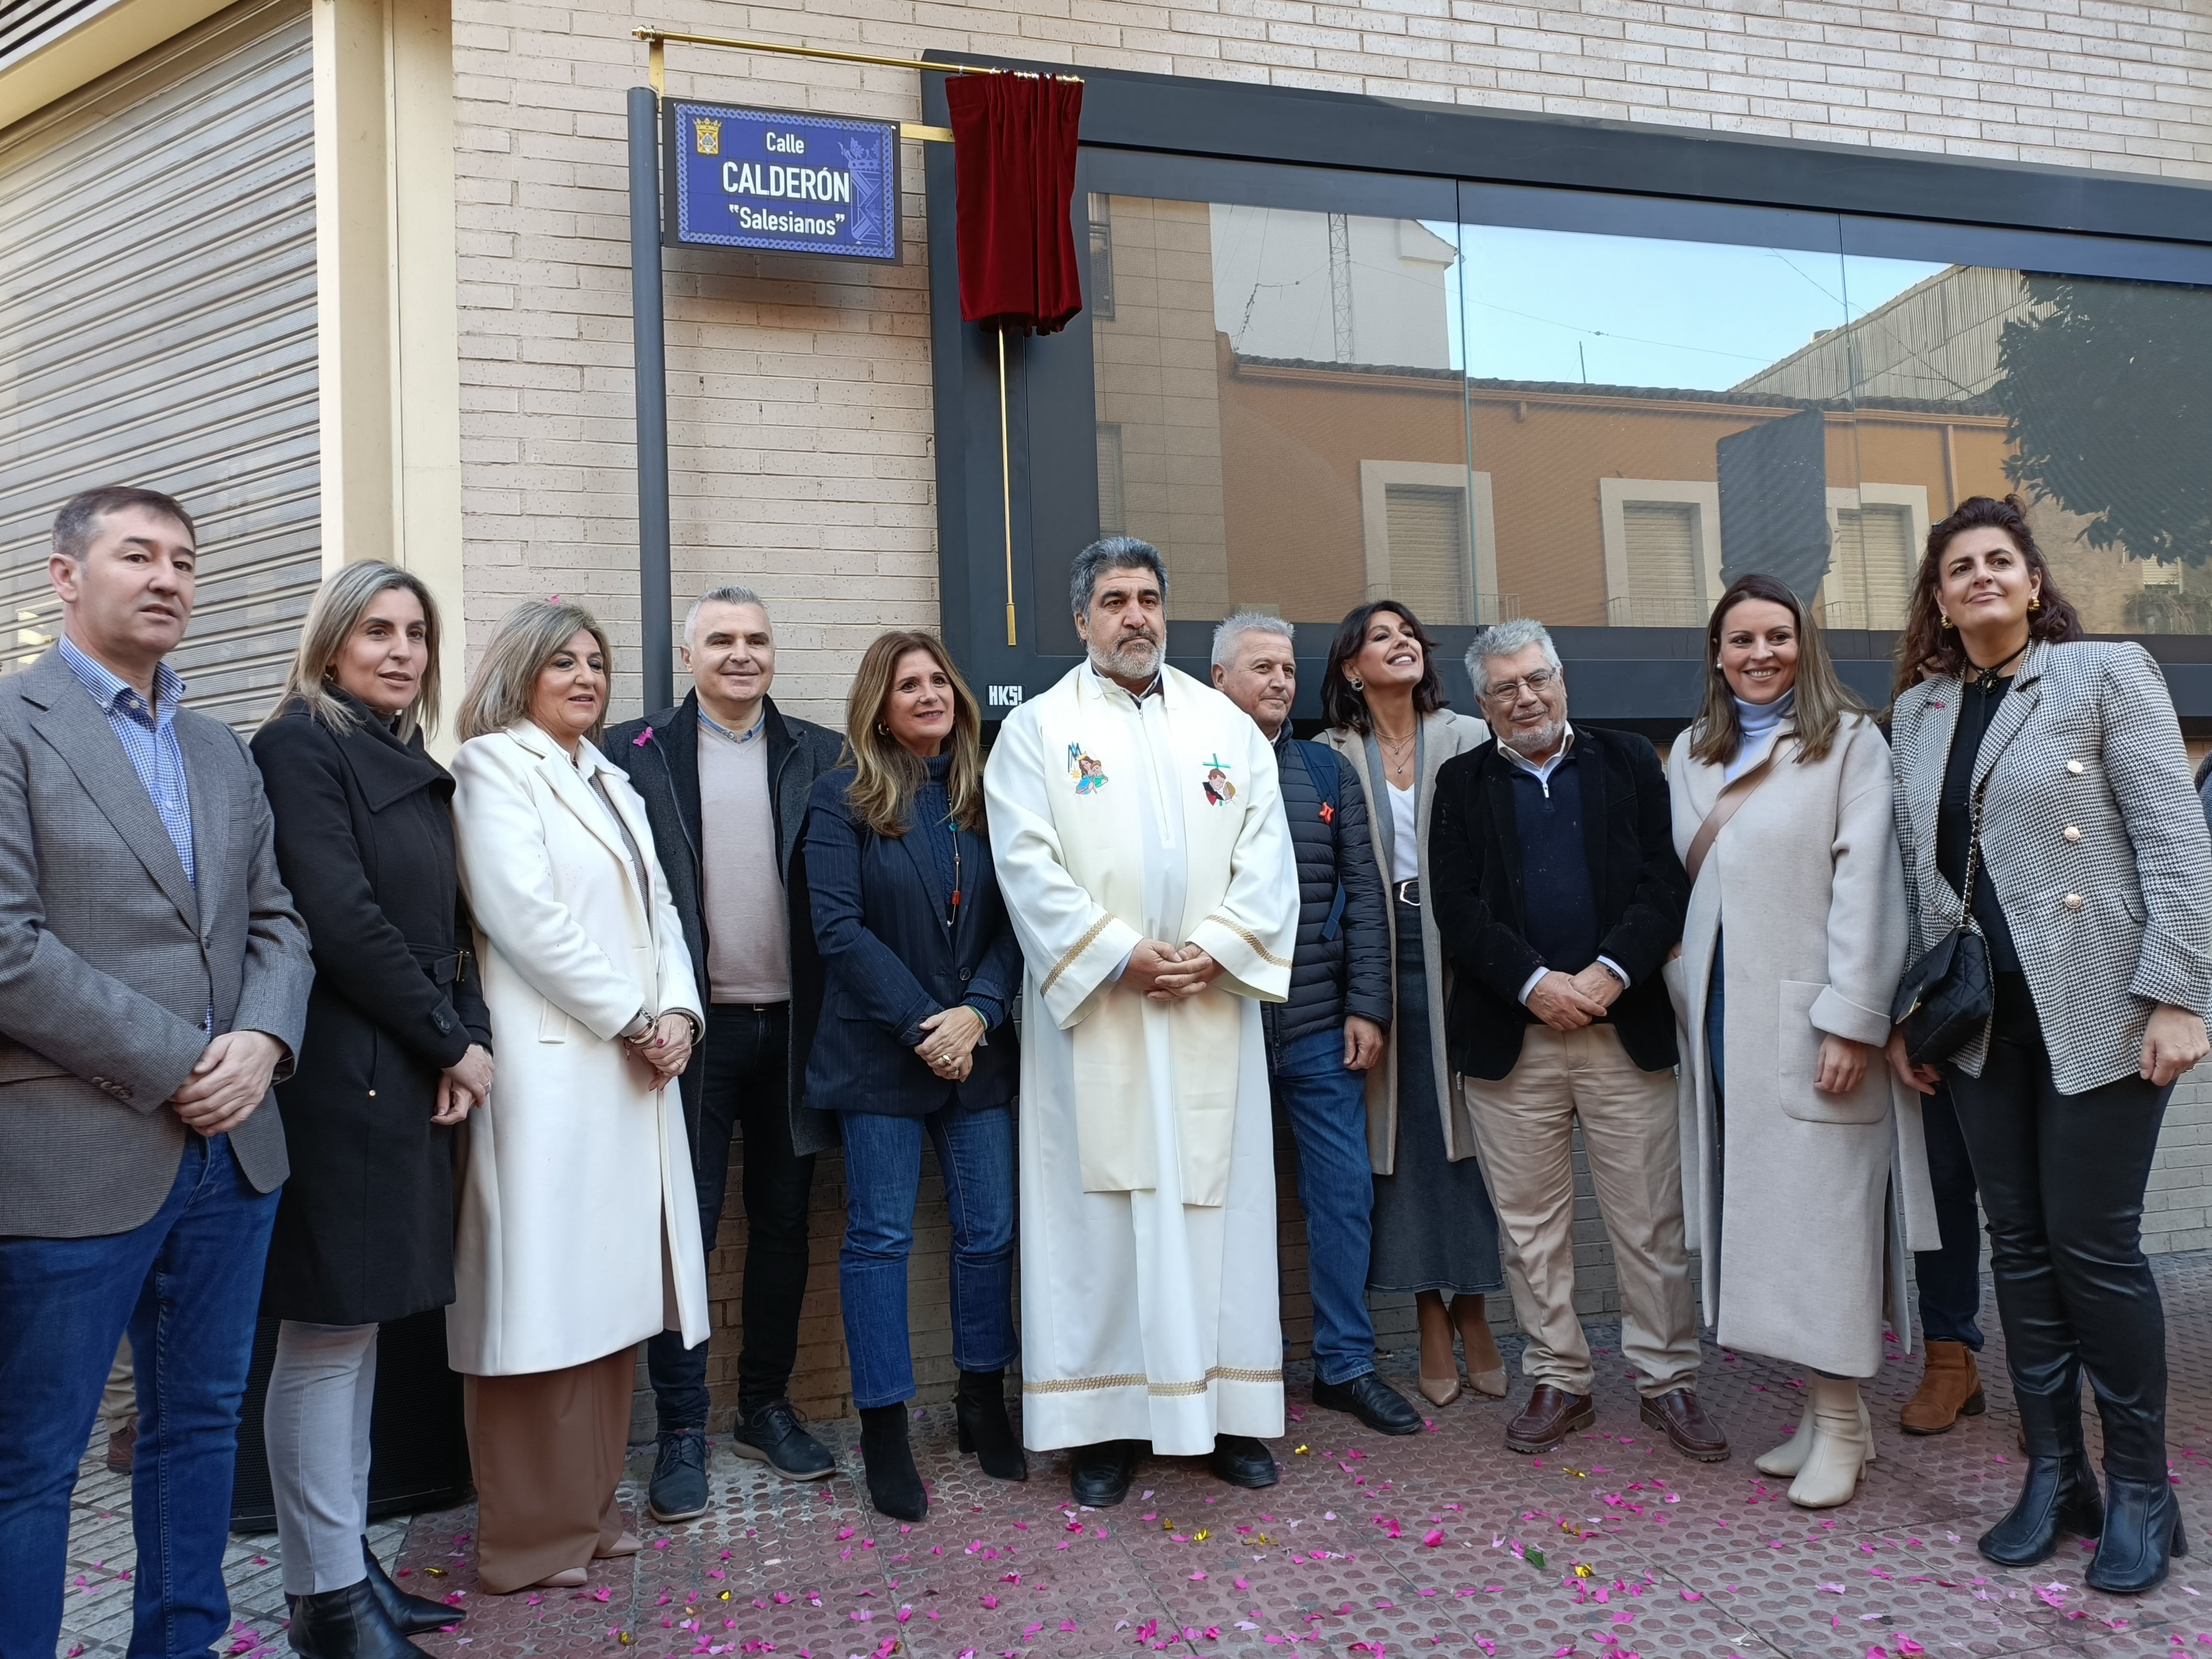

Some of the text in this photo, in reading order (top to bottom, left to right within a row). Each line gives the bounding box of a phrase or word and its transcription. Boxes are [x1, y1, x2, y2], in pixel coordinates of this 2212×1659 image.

[766, 132, 805, 155] Calle
[723, 161, 850, 203] CALDERÓN
[729, 204, 845, 236] “Salesianos”
